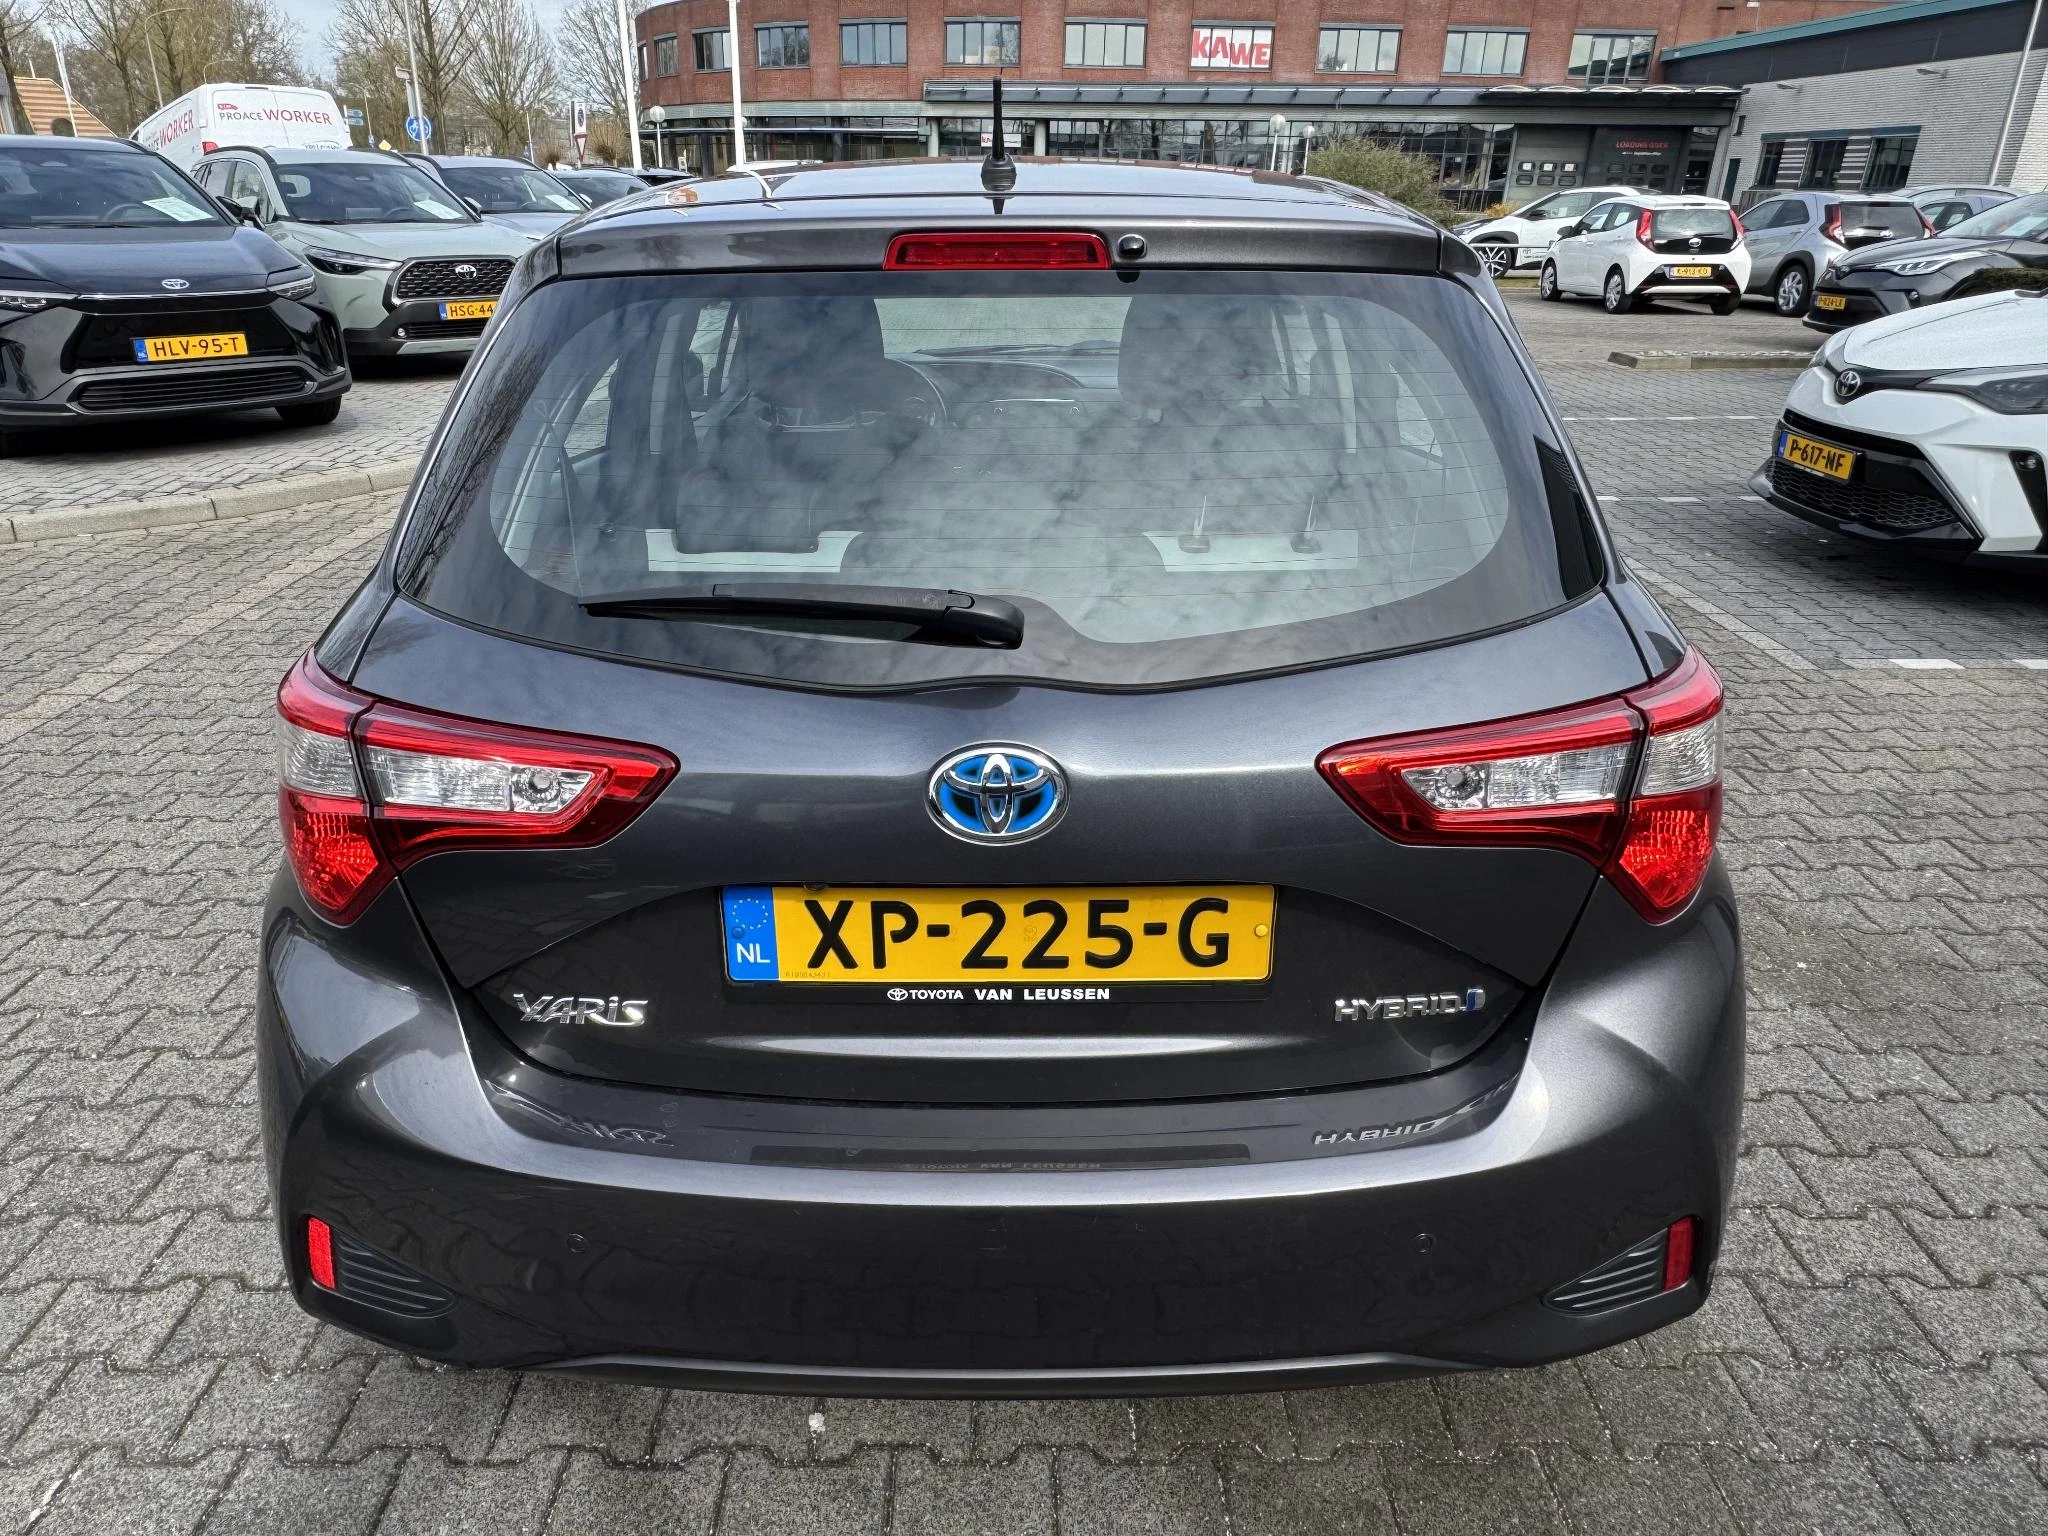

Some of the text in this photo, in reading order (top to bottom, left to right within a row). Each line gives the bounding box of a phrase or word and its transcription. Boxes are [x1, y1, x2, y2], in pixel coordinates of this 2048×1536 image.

[160, 109, 194, 148] WORKER
[220, 112, 263, 121] PROACE
[263, 108, 332, 125] WORKER
[153, 337, 239, 357] HLV-95-T
[1789, 438, 1846, 473] P-617-NF
[804, 897, 1230, 970] XP-225-G
[736, 942, 771, 964] NL
[911, 988, 1110, 1000] TOYOTA VAN LEUSSEN
[1334, 992, 1462, 1022] HYBRID
